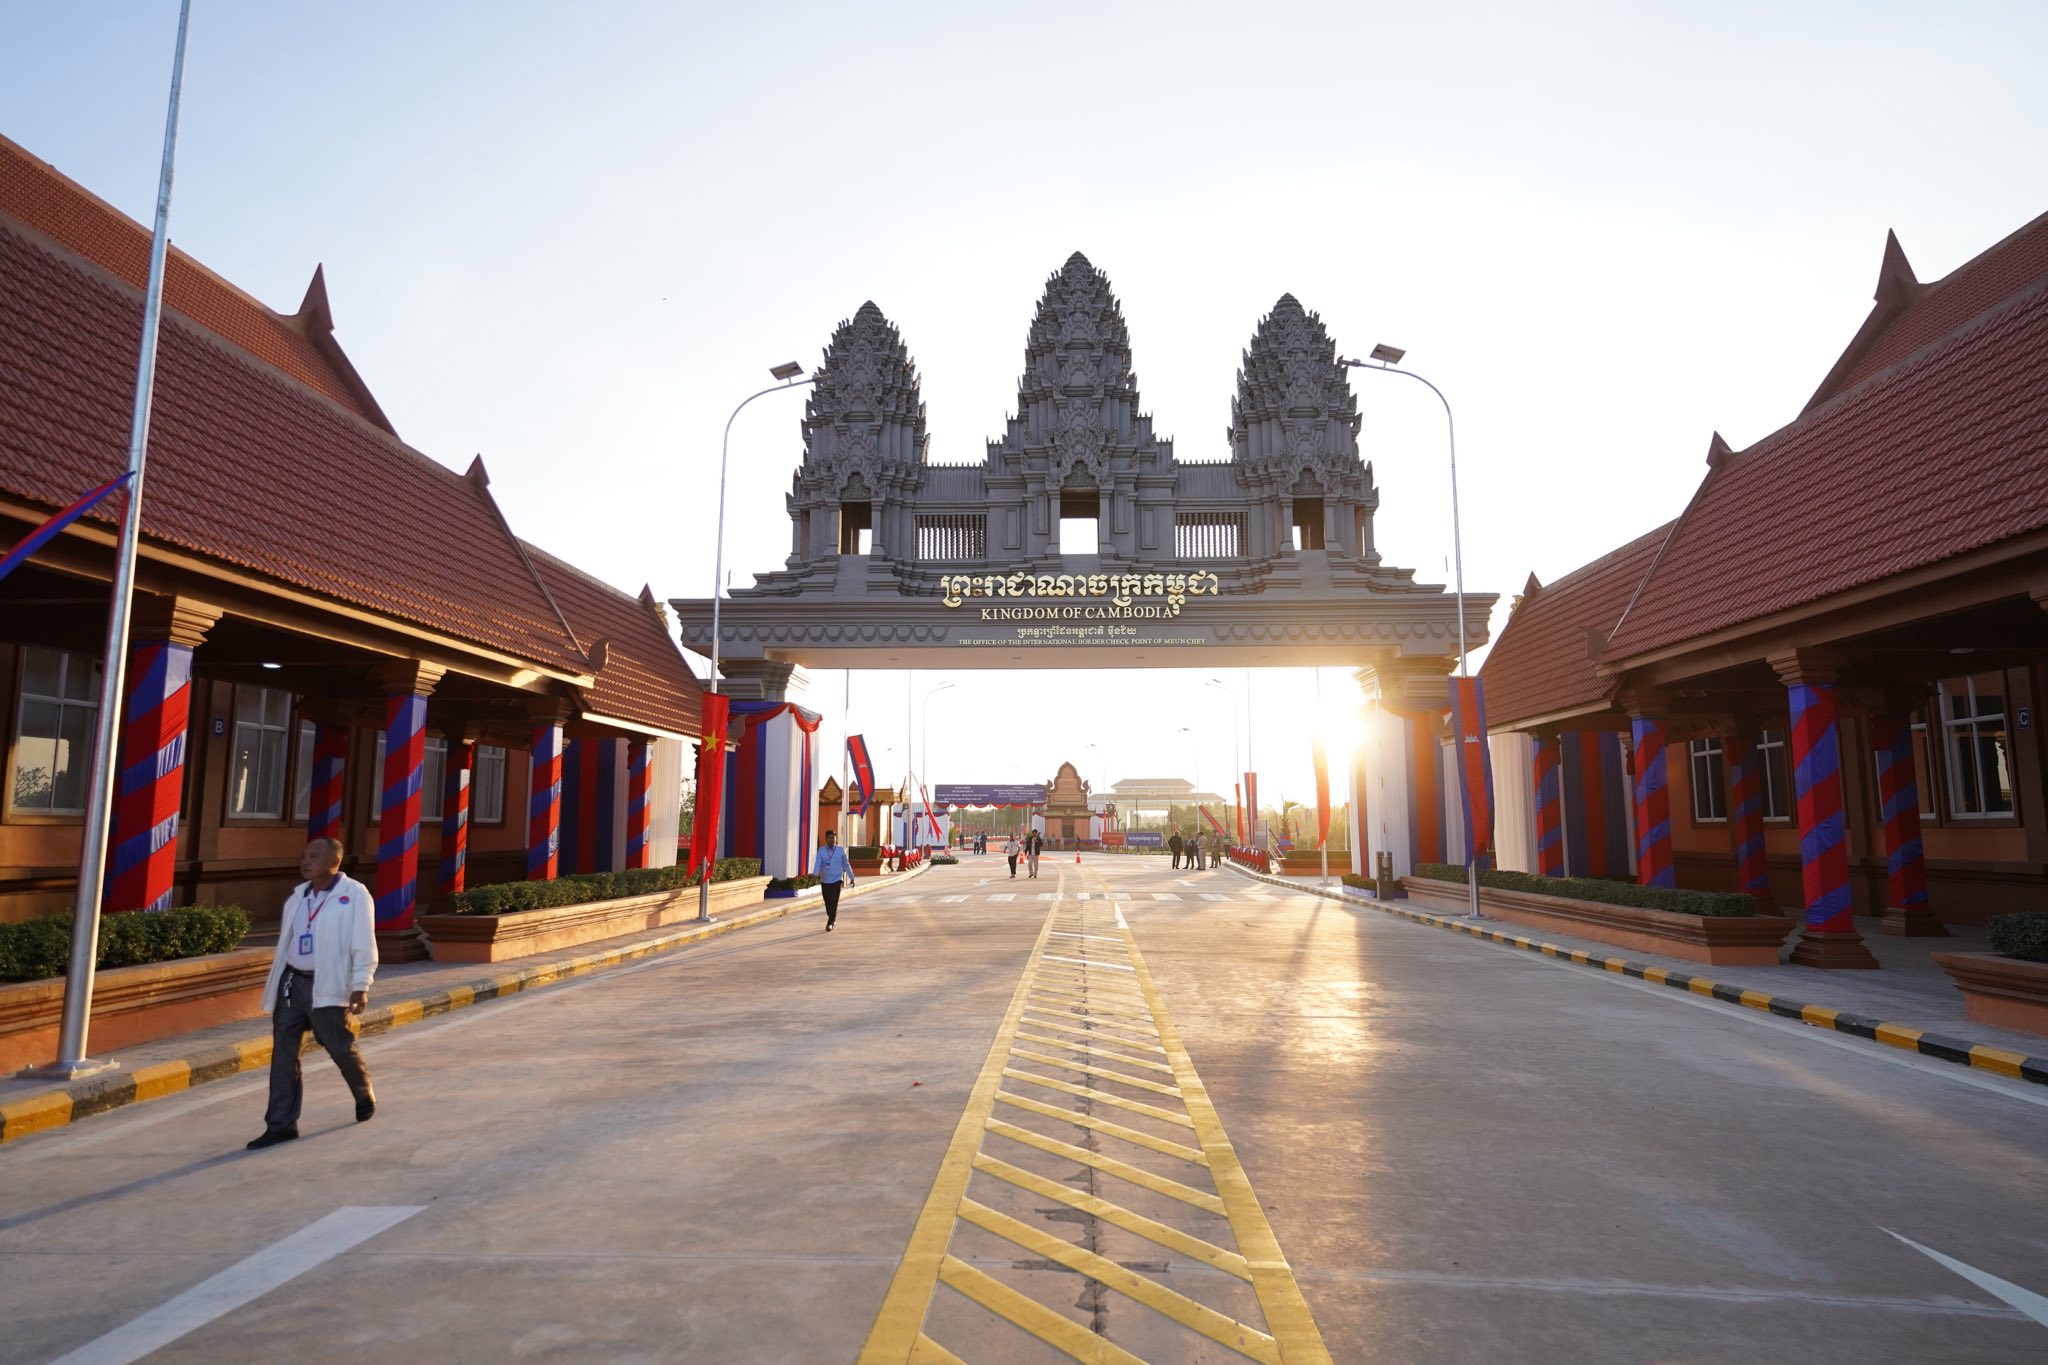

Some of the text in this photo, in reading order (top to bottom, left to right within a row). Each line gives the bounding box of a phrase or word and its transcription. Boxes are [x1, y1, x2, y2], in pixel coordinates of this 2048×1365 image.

[940, 570, 1218, 615] ព្រះរាជាណាចក្រកម្ពុជា
[981, 606, 1174, 620] KINGDOM OF CAMBODIA
[2020, 712, 2028, 725] C
[216, 720, 223, 733] B
